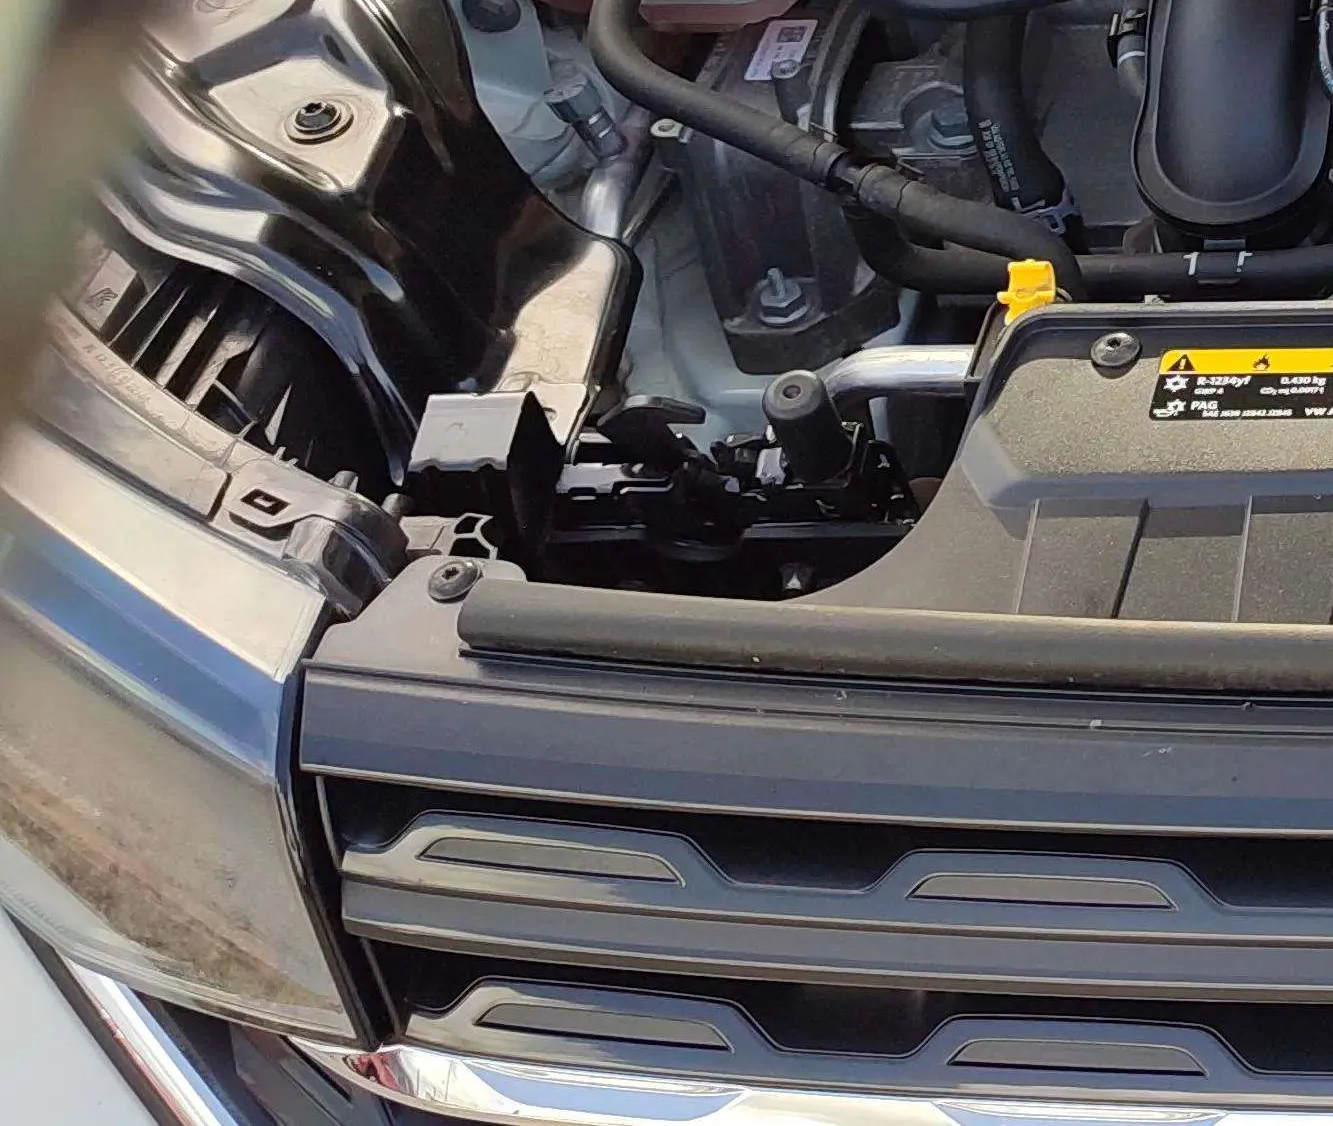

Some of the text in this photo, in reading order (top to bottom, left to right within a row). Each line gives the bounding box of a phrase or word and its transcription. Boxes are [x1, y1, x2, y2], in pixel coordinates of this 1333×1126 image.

[1197, 376, 1252, 388] R-1234yf
[1191, 401, 1218, 410] PAG
[1305, 407, 1327, 416] VW
